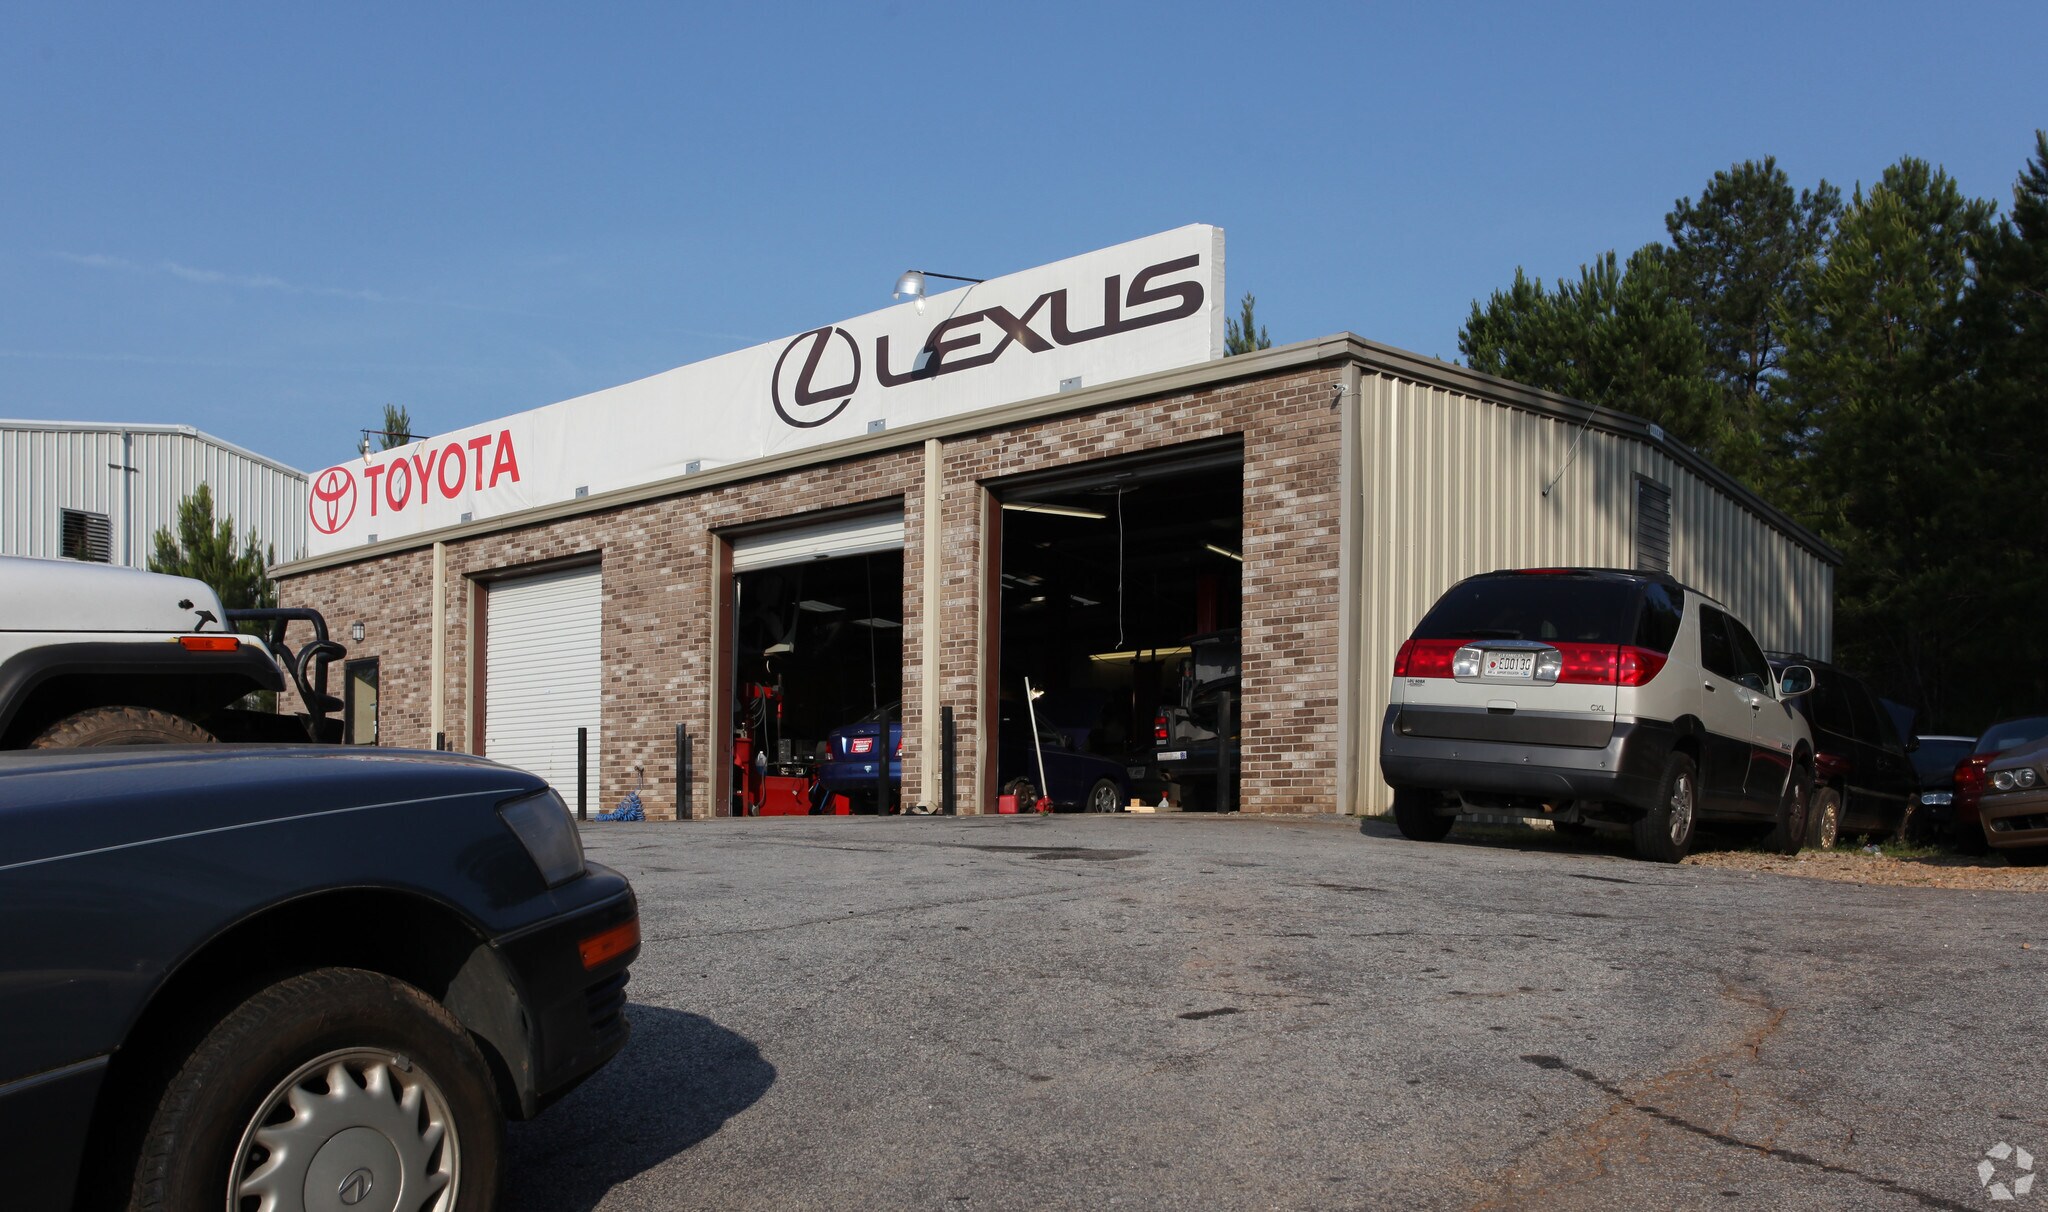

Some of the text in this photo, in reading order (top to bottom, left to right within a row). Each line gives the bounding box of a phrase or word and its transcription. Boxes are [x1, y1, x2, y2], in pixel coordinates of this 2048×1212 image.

[876, 253, 1205, 388] LEXUS
[364, 429, 521, 517] TOYOTA
[1590, 704, 1605, 712] CXL
